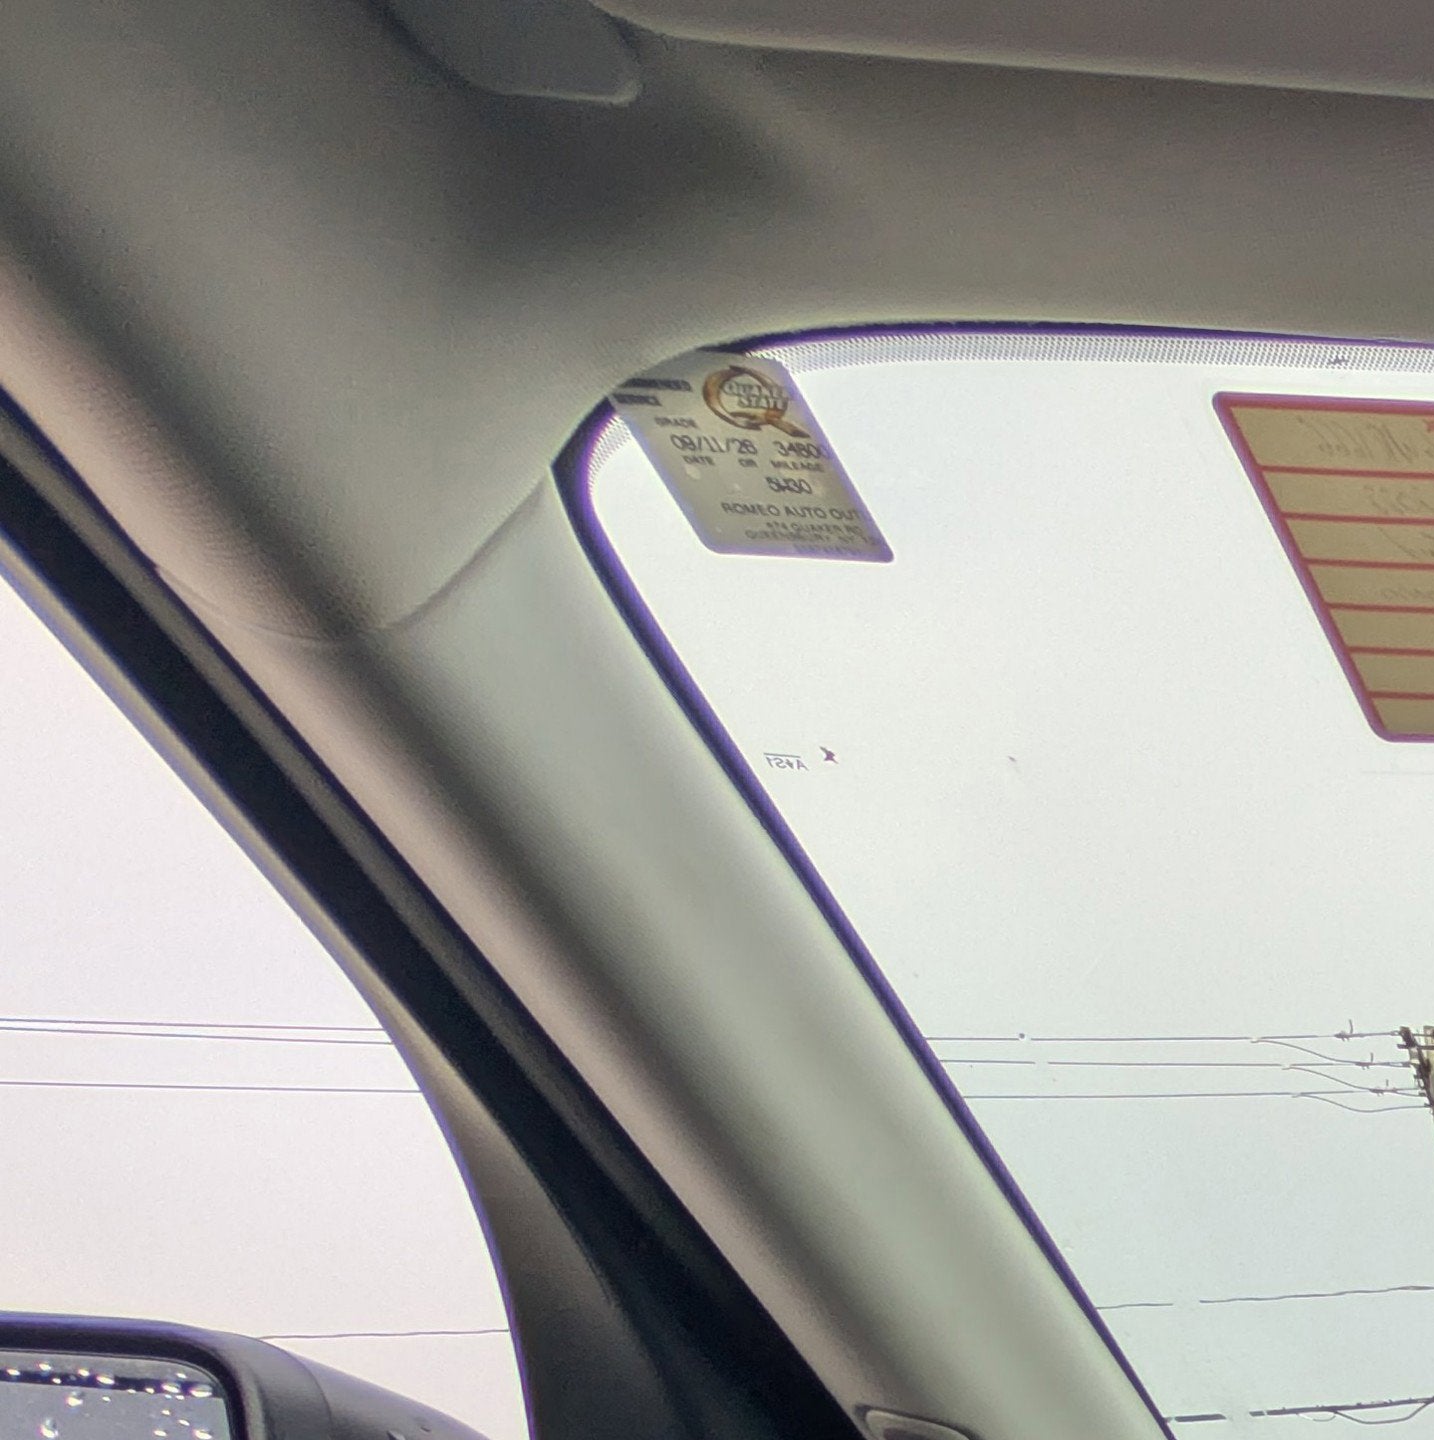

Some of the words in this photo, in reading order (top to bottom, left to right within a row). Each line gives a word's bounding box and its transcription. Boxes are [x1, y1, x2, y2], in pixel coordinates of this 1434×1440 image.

[682, 454, 716, 466] DATE
[737, 459, 758, 468] OR
[769, 459, 827, 473] MILEAGE
[721, 501, 780, 518] ROMEO
[784, 505, 828, 520] AUTO
